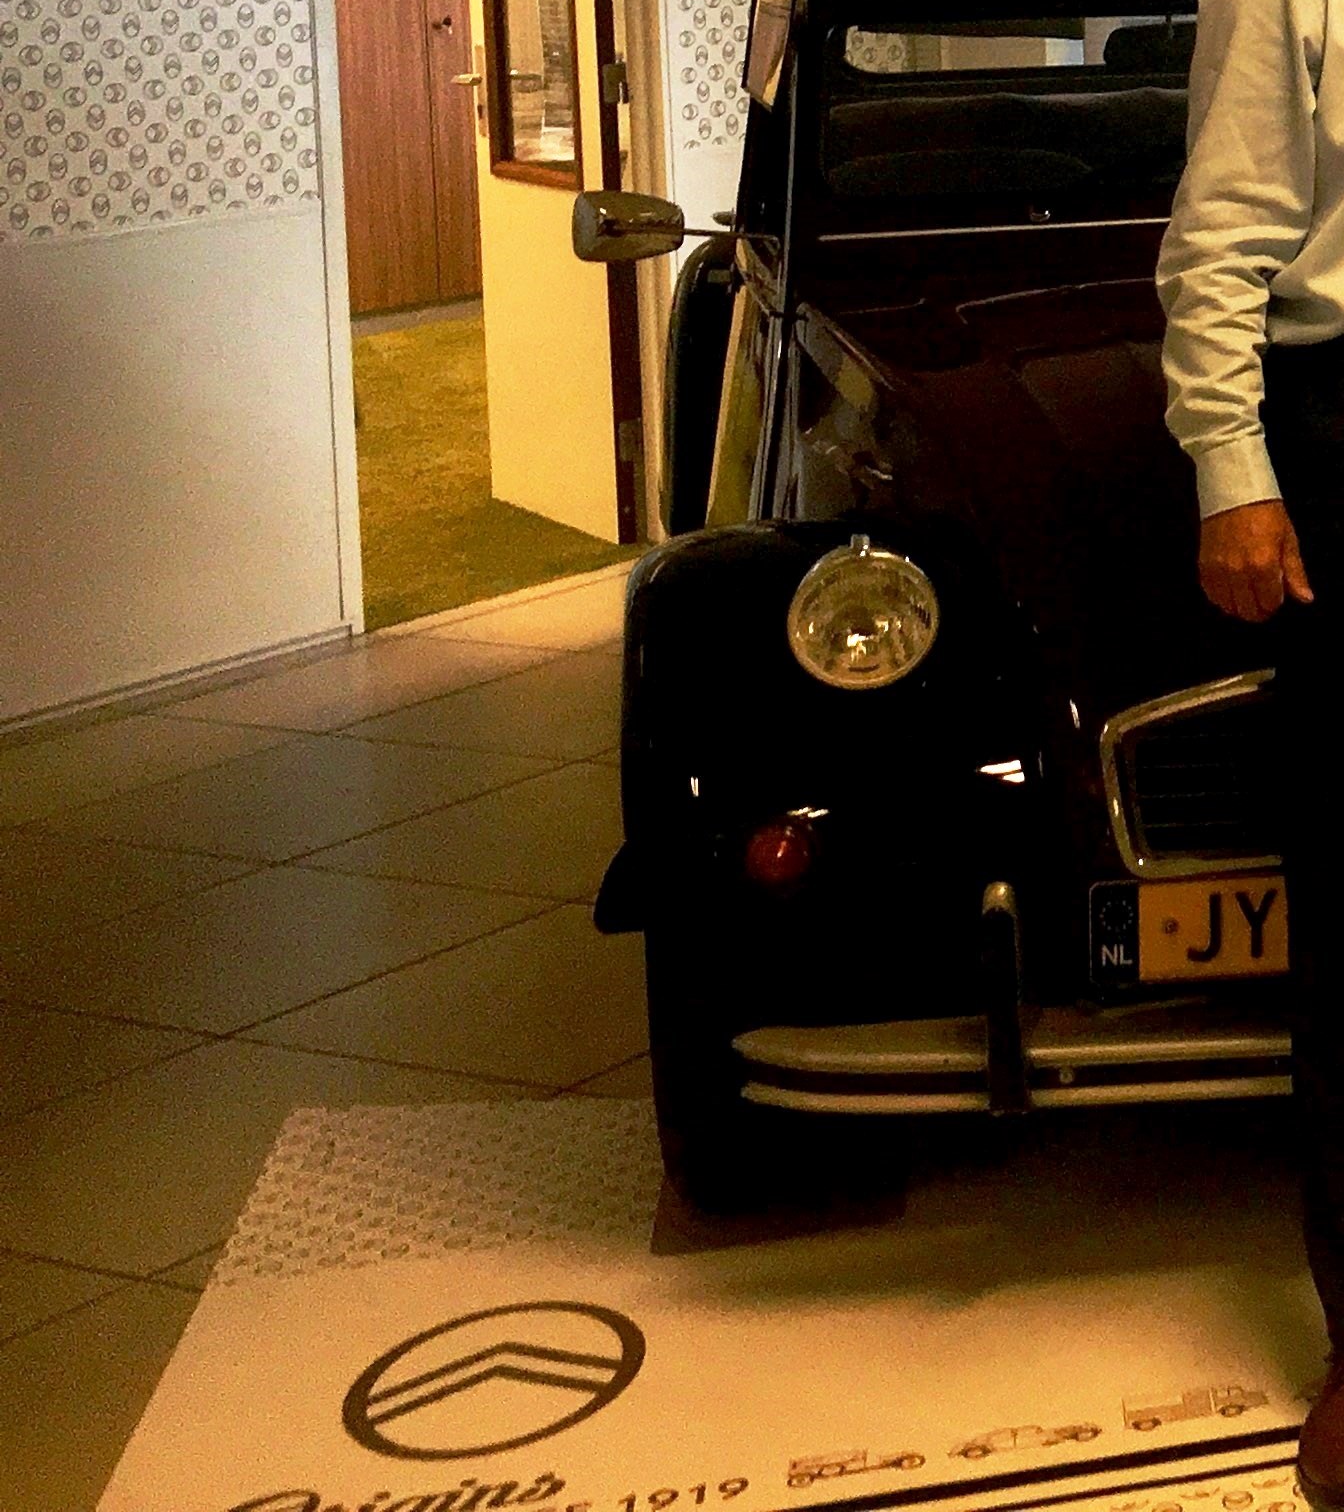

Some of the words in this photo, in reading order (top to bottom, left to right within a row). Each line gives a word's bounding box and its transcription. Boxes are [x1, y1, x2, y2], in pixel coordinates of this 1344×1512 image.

[1186, 888, 1278, 963] JY
[1101, 944, 1133, 966] NL
[228, 1472, 566, 1512] gins
[618, 1477, 749, 1512] 1919
